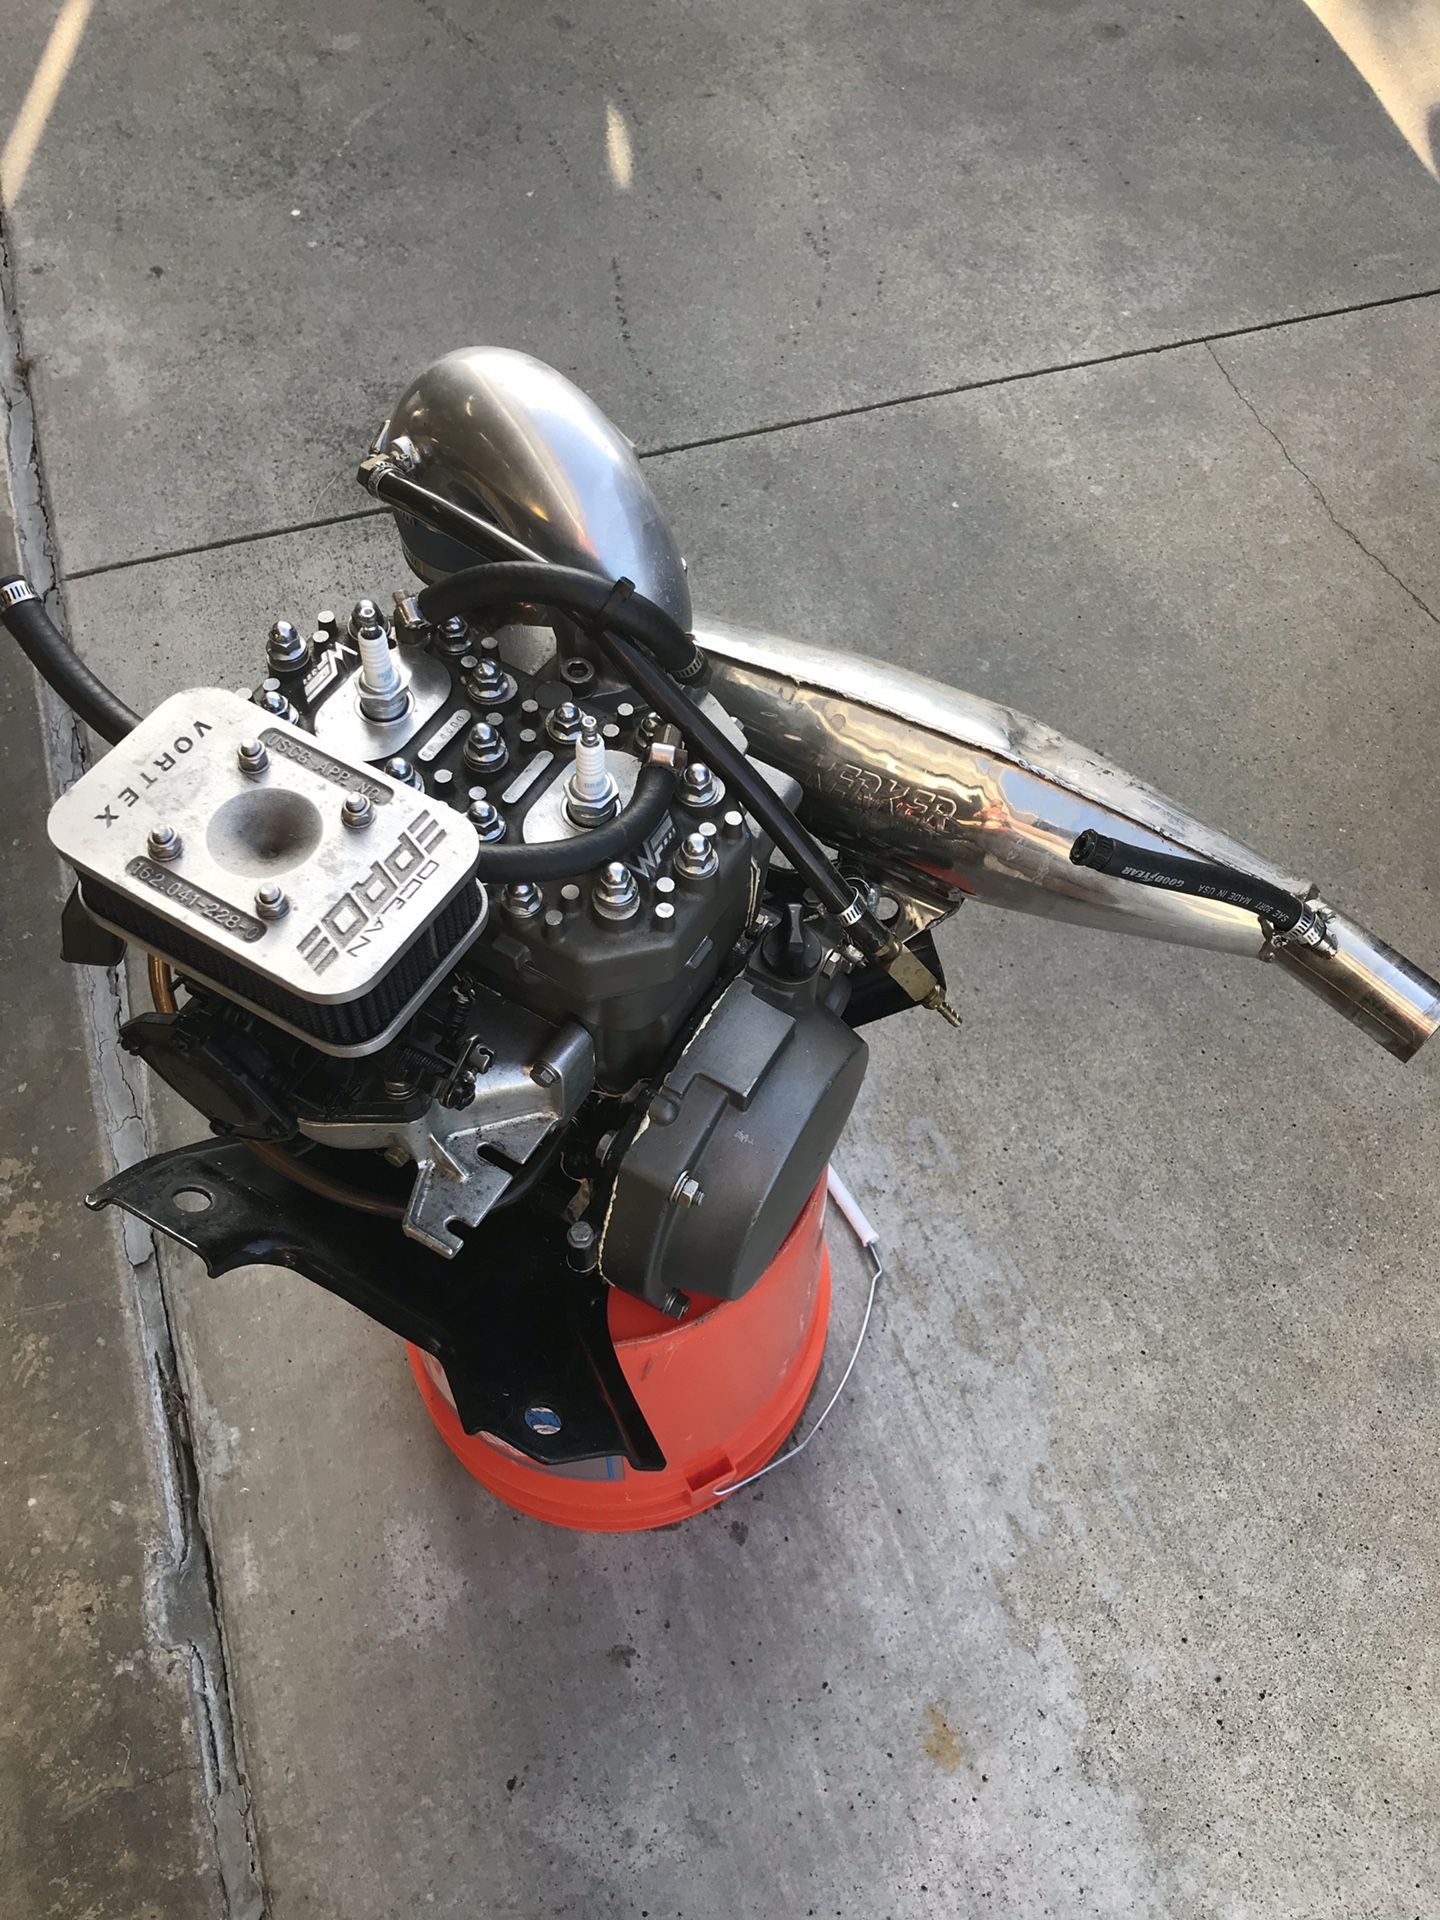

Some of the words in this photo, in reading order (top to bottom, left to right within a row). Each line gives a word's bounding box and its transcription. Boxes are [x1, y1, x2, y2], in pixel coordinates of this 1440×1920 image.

[266, 733, 312, 764] USCG
[94, 720, 212, 828] VORTEX
[1121, 866, 1185, 887] GOODYEAR
[1199, 884, 1215, 895] USA
[131, 861, 260, 940] 162.041-228-0
[321, 832, 426, 948] PRO
[1216, 888, 1227, 898] IN
[1228, 892, 1252, 905] MADE
[346, 860, 439, 957] OCEAN
[1272, 909, 1290, 922] SAE
